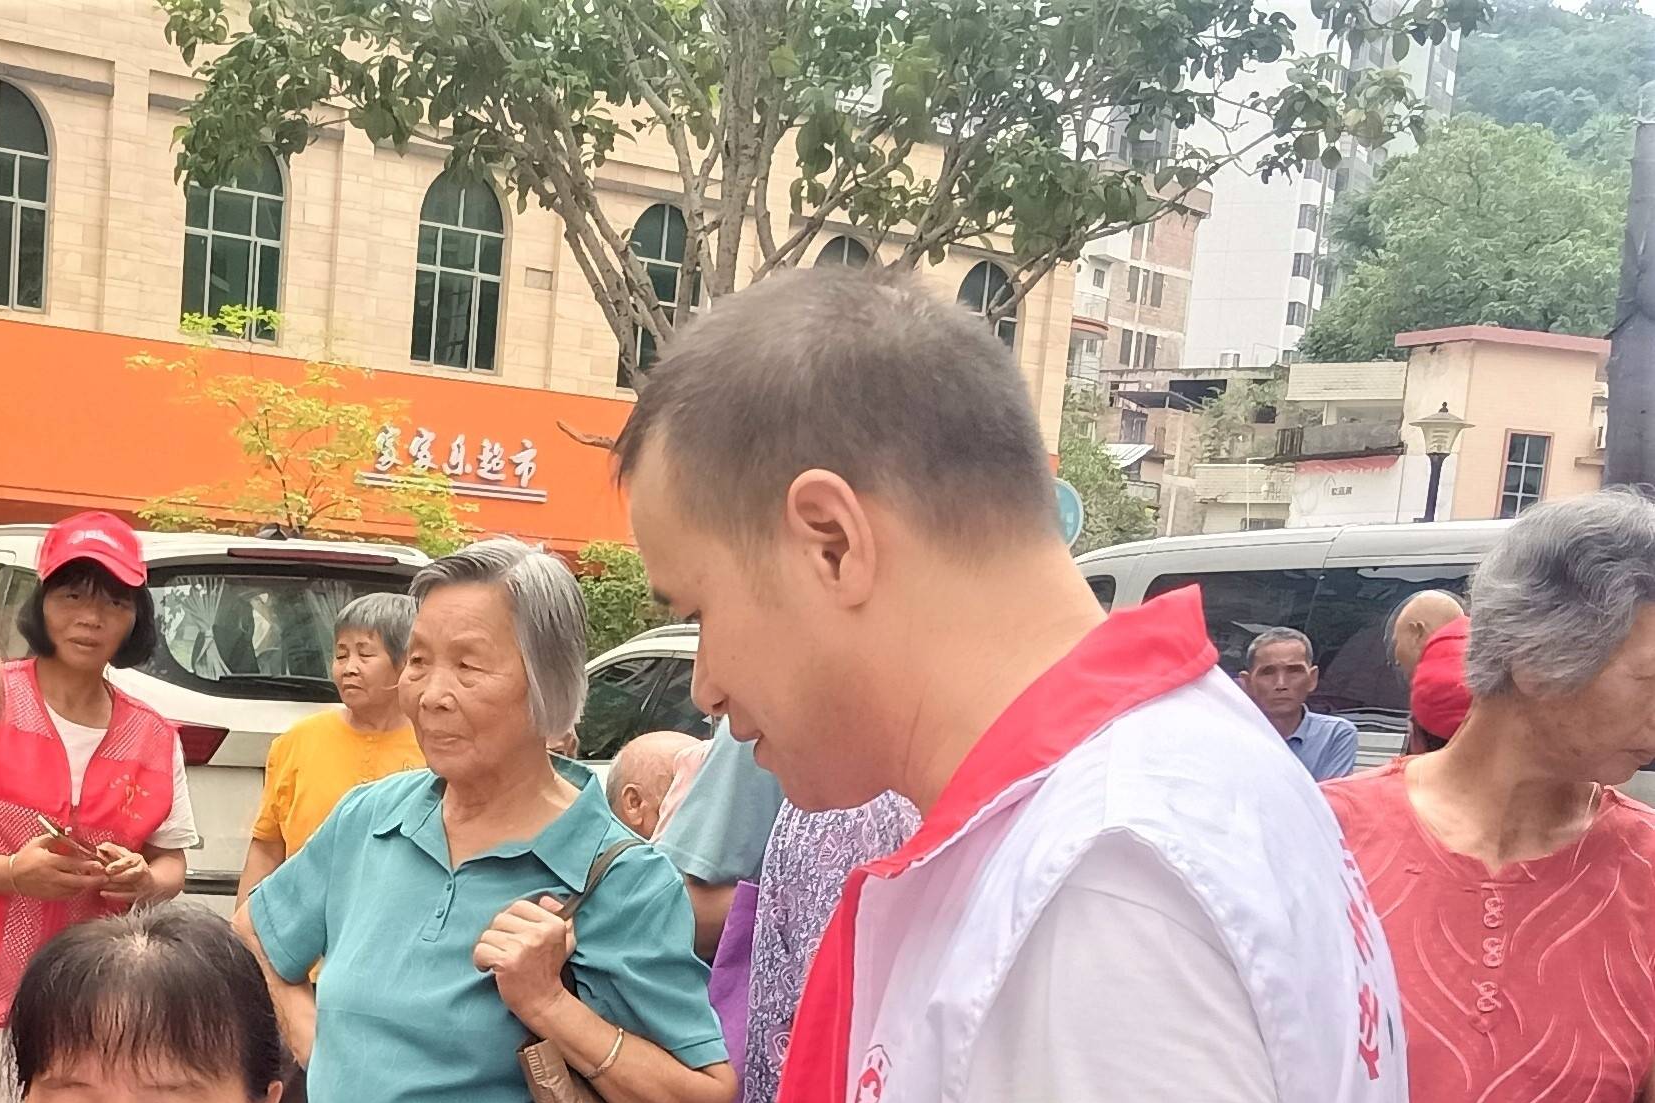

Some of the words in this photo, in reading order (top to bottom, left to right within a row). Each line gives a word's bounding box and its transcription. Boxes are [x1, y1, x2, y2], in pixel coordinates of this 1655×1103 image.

[375, 424, 538, 488] 家家乐超市
